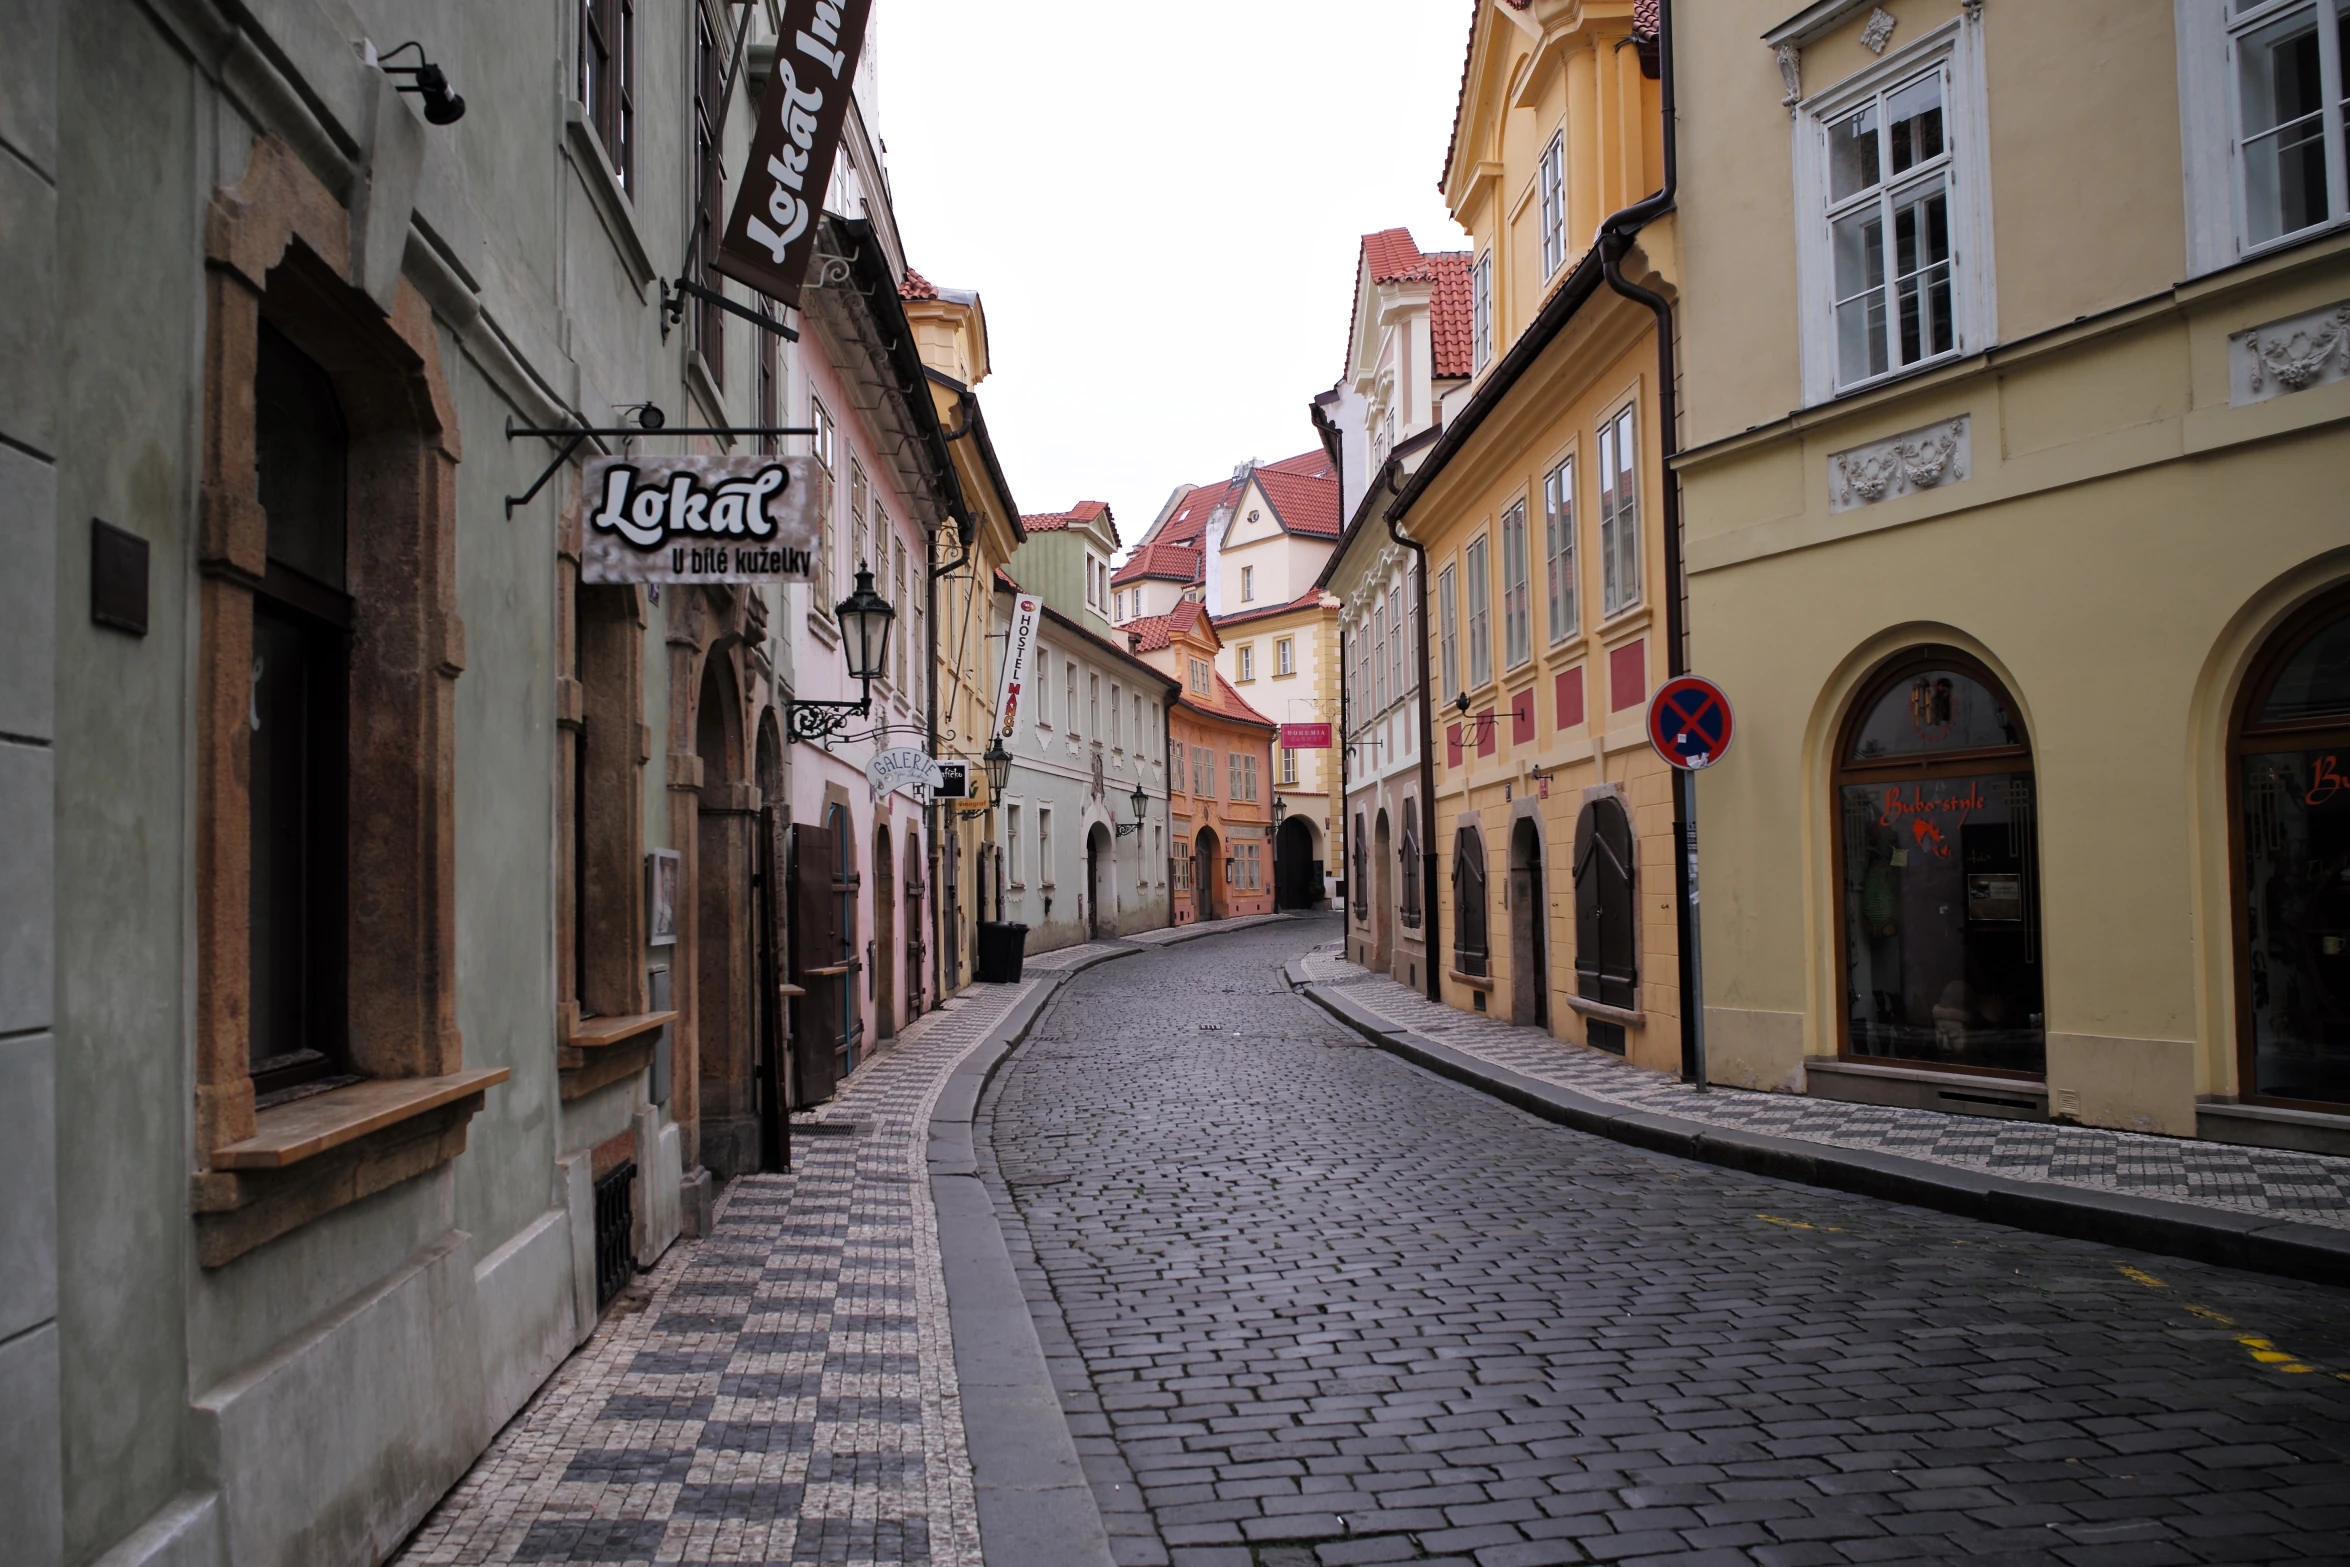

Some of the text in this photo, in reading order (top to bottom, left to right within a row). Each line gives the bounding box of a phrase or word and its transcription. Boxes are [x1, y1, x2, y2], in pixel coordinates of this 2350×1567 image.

[747, 0, 847, 264] Lokal In
[593, 466, 786, 549] Lokal
[672, 547, 811, 577] U bílé kuželky
[1002, 614, 1031, 738] HOSTEL MANGO
[873, 751, 937, 777] GALERIE
[1880, 780, 1986, 830] Bubo-style
